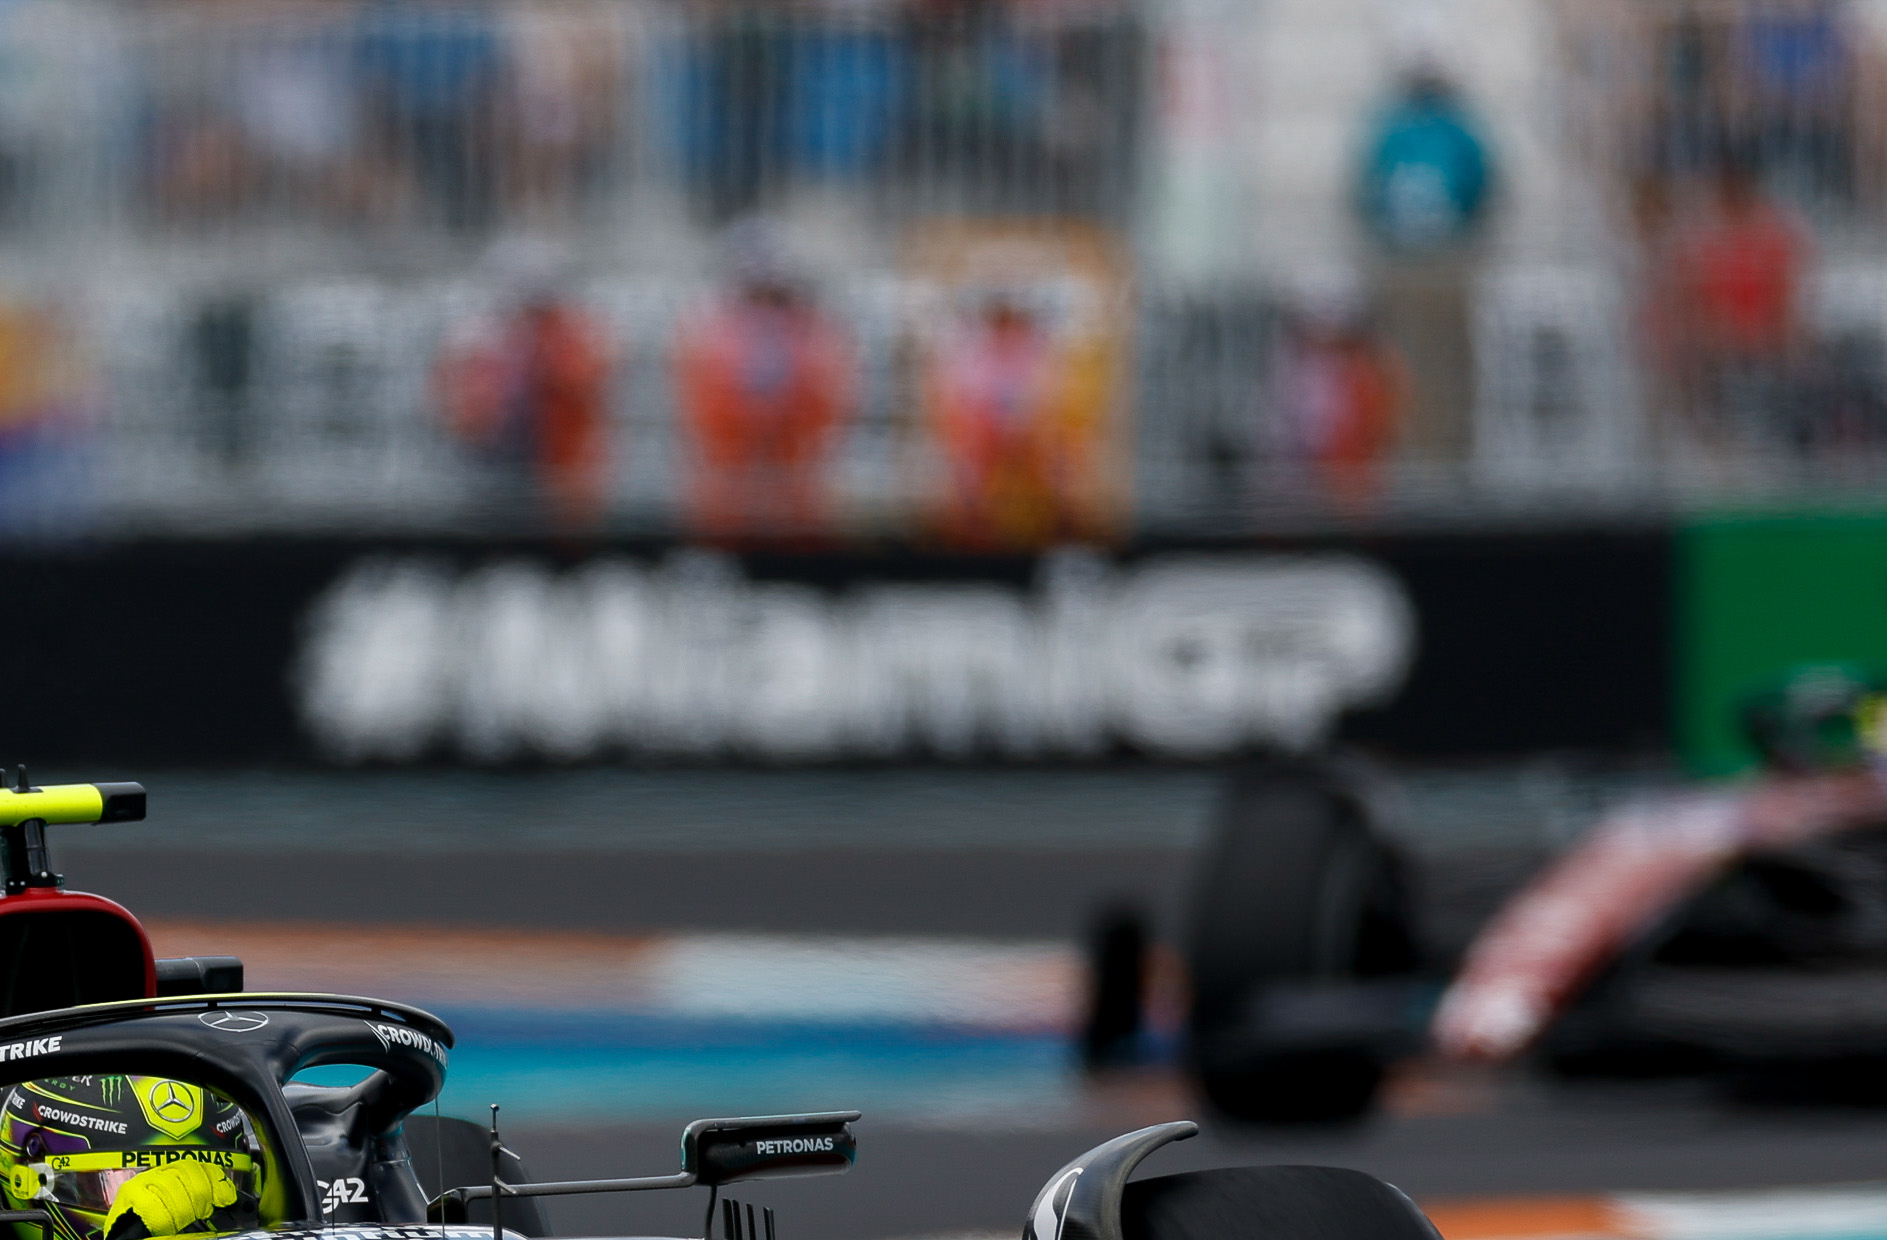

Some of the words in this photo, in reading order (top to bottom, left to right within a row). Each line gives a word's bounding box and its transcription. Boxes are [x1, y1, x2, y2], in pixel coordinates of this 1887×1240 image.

[38, 1105, 128, 1135] CROWDSTRIKE
[756, 1137, 834, 1155] PETRONAS
[51, 1156, 71, 1170] G42
